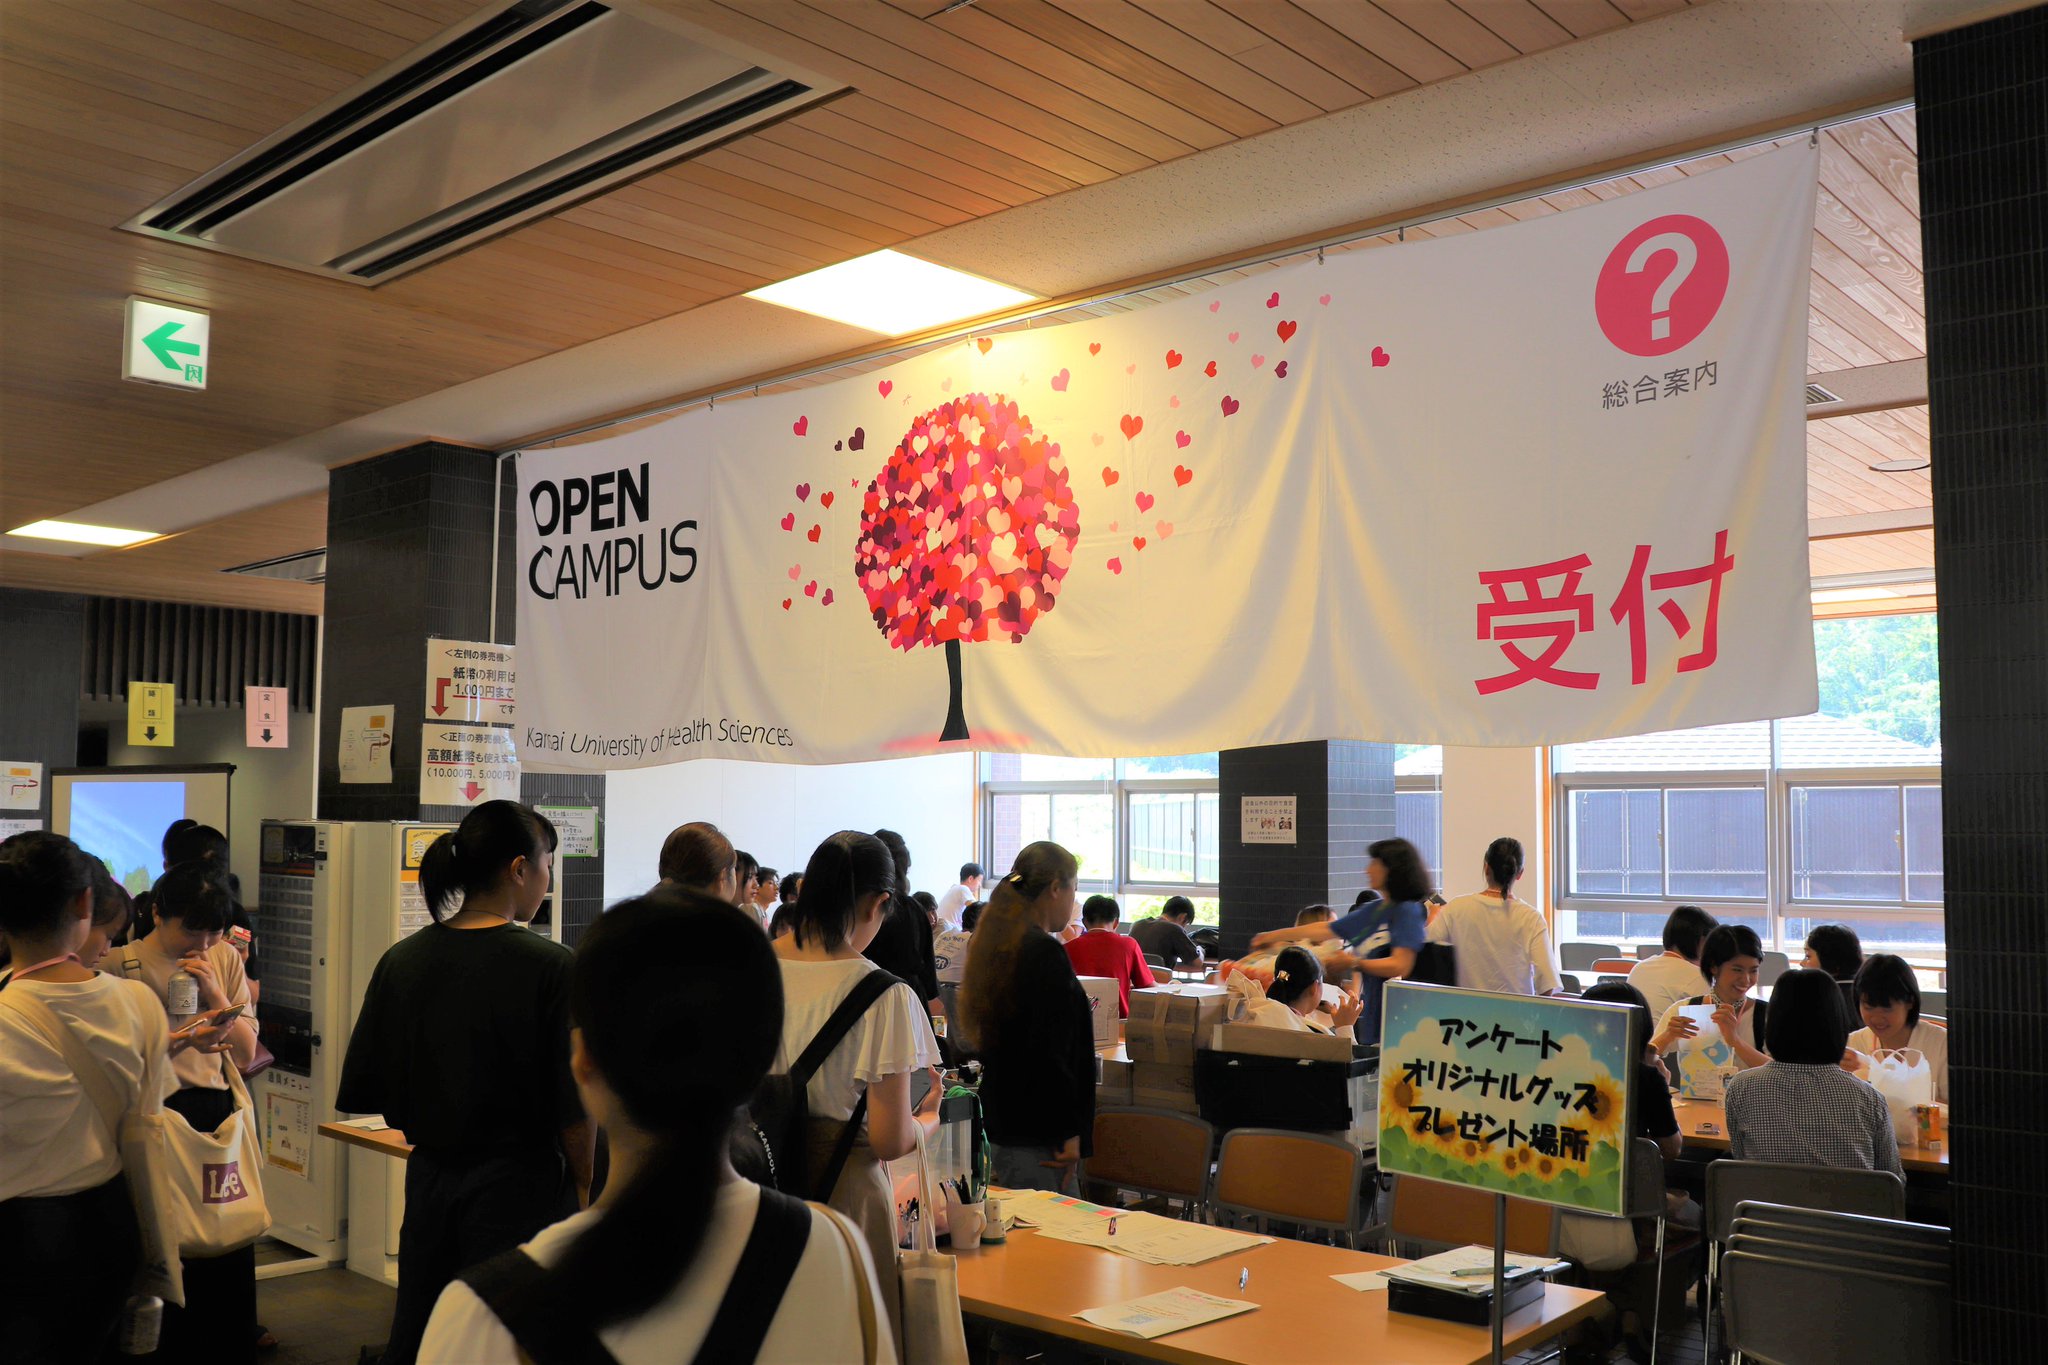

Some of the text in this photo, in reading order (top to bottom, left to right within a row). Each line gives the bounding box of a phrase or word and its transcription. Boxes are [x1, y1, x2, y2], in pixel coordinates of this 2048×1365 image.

[1602, 360, 1718, 410] 総合案内
[529, 462, 649, 537] OPEN
[528, 520, 698, 600] CAMPUS
[1474, 528, 1735, 695] 受付
[453, 666, 516, 683] 紙幣の利用は
[499, 704, 516, 715] です
[570, 733, 648, 760] University
[650, 728, 665, 752] of
[666, 717, 712, 749] Health
[717, 718, 794, 747] Sciences
[1439, 1018, 1564, 1060] アンケート
[1402, 1058, 1598, 1114] オリジナルグッズ
[1408, 1105, 1590, 1162] プレゼント場所
